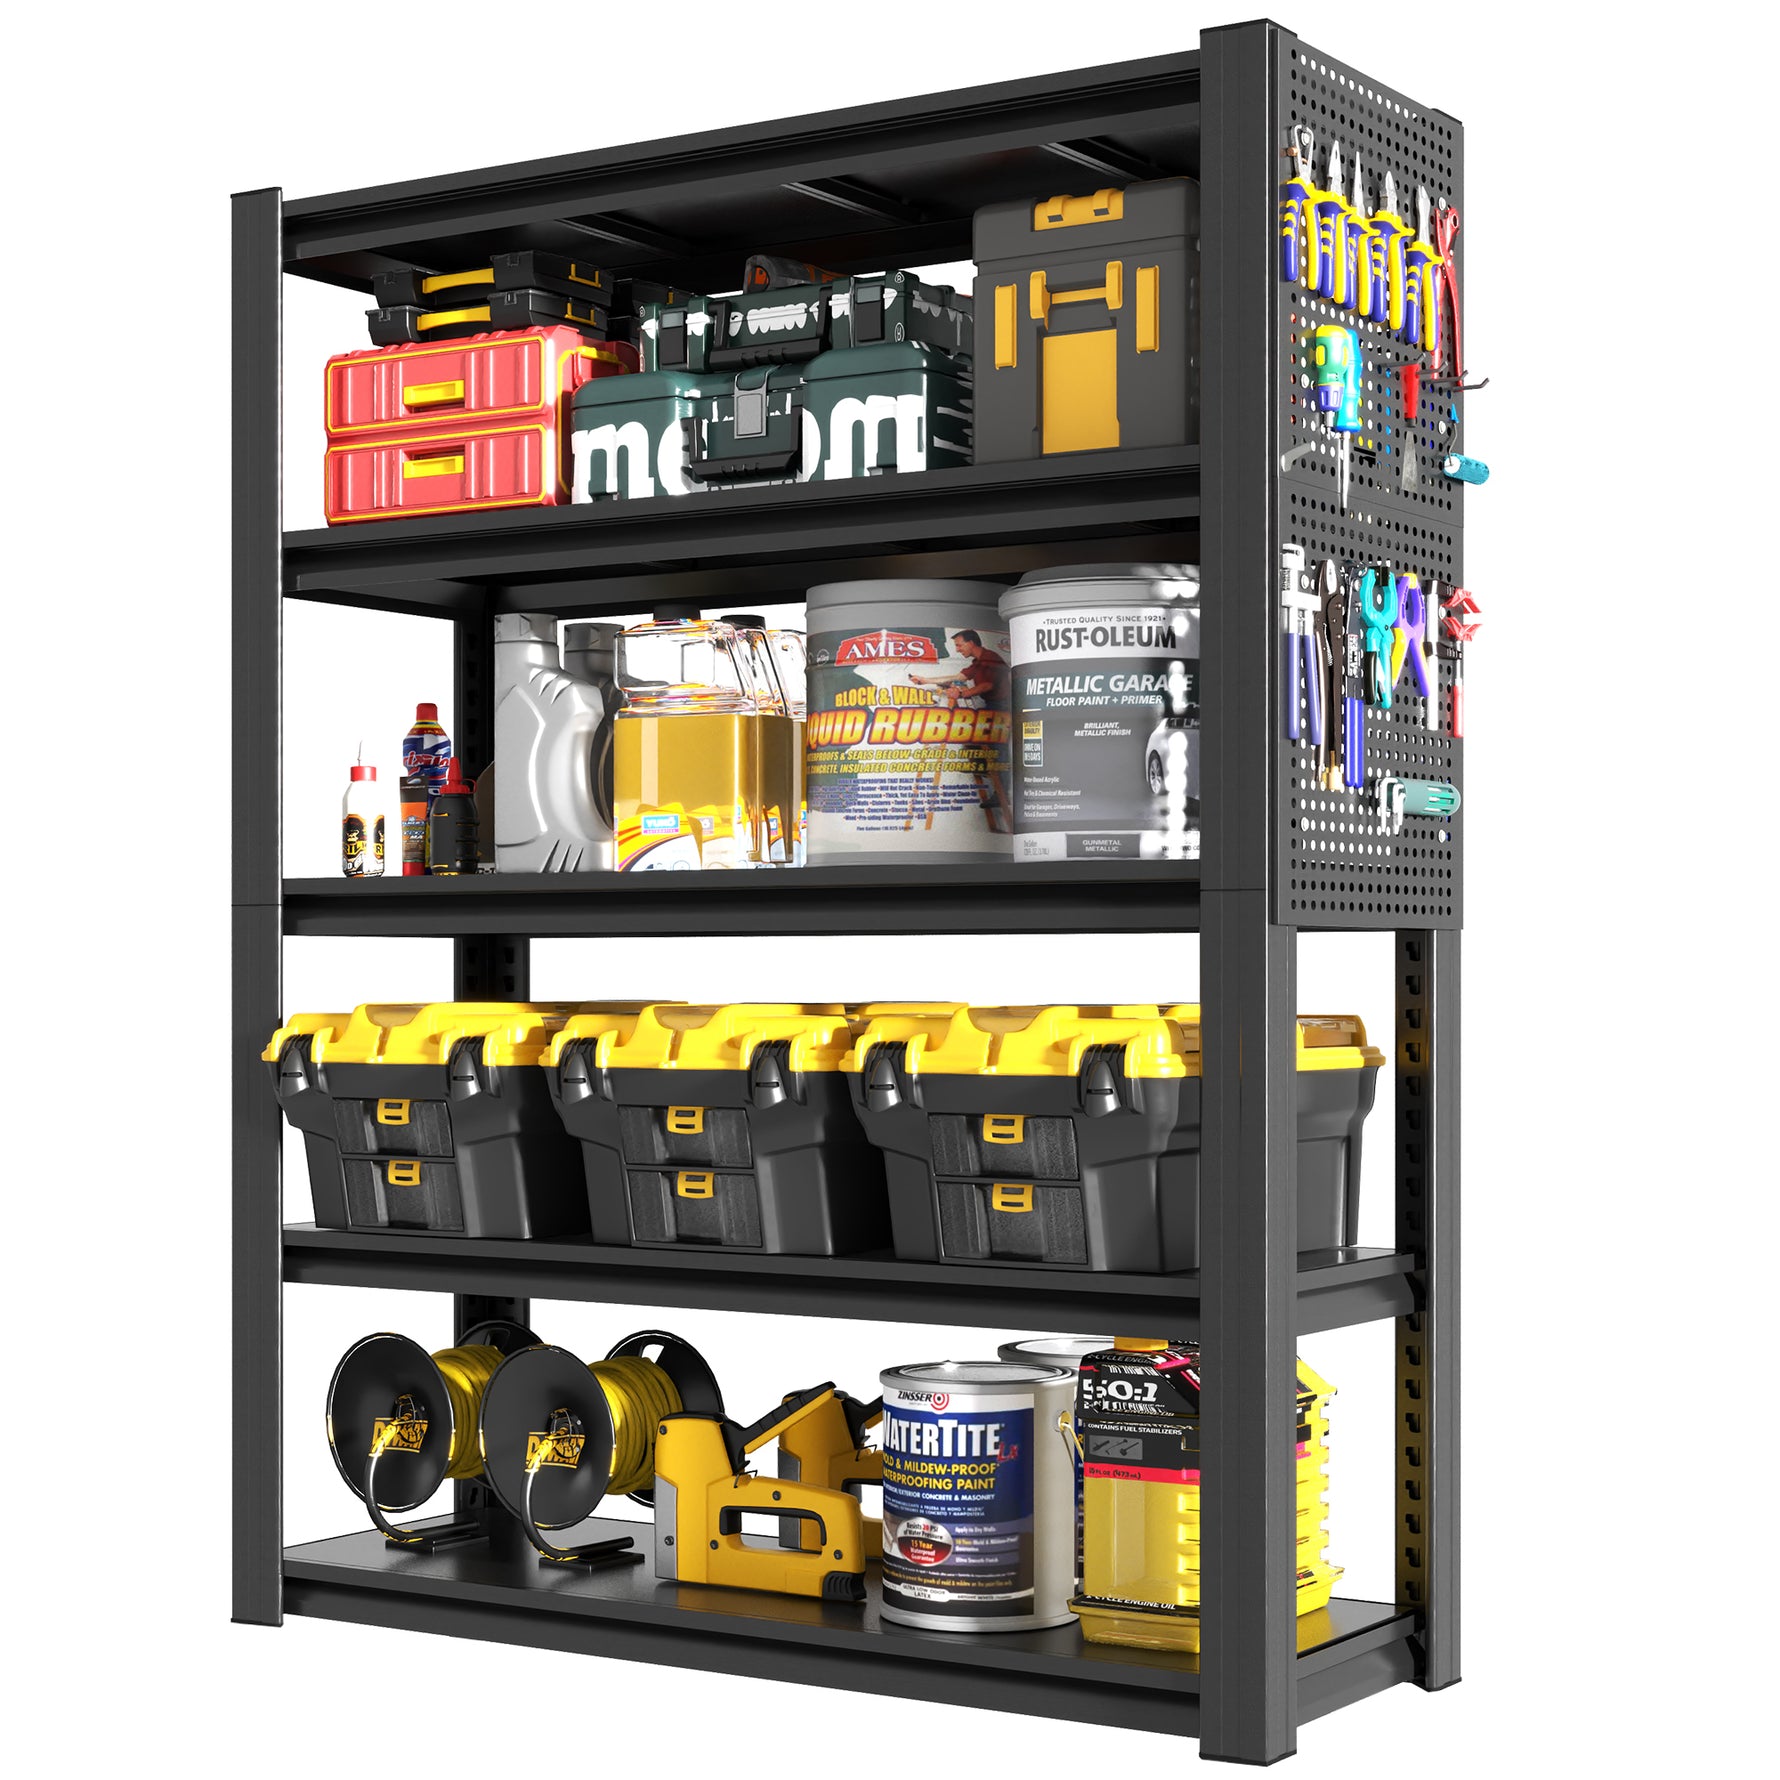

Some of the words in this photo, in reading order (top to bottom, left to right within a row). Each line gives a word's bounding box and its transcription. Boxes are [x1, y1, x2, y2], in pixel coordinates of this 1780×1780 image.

[1079, 615, 1113, 624] QUALITY
[1116, 615, 1142, 623] SINCE
[1036, 625, 1176, 653] RUST-OLEUM
[845, 640, 926, 660] AMES
[1026, 674, 1105, 696] METALLIC
[1109, 673, 1193, 692] GARAE
[834, 686, 878, 708] BLOCK
[878, 687, 892, 706] &
[892, 685, 935, 706] WALL
[1046, 696, 1076, 707] FLOOR
[1078, 695, 1111, 706] PAINT
[1121, 694, 1164, 705] PRIMER
[868, 706, 1010, 746] RUBBER
[1074, 729, 1107, 738] METALLIC
[1107, 729, 1132, 737] FINISH
[847, 750, 873, 761] SEALS
[840, 763, 888, 774] INSULATED
[889, 761, 943, 774] CONCRETE
[943, 761, 977, 773] FORMS
[1085, 845, 1120, 853] METALLIC
[897, 1390, 933, 1402] ZINSSER
[1088, 1422, 1120, 1431] CONTAINS
[1120, 1424, 1138, 1432] FUEL
[1138, 1426, 1183, 1436] STABILIZERS
[956, 1477, 996, 1490] PAINT
[922, 1491, 953, 1501] CONCRETE
[922, 1531, 943, 1540] Pressure
[911, 1539, 919, 1548] 15
[919, 1540, 934, 1550] Year
[910, 1547, 936, 1557] Waterproof
[914, 1591, 931, 1600] LATEX
[1160, 1602, 1176, 1610] OIL
